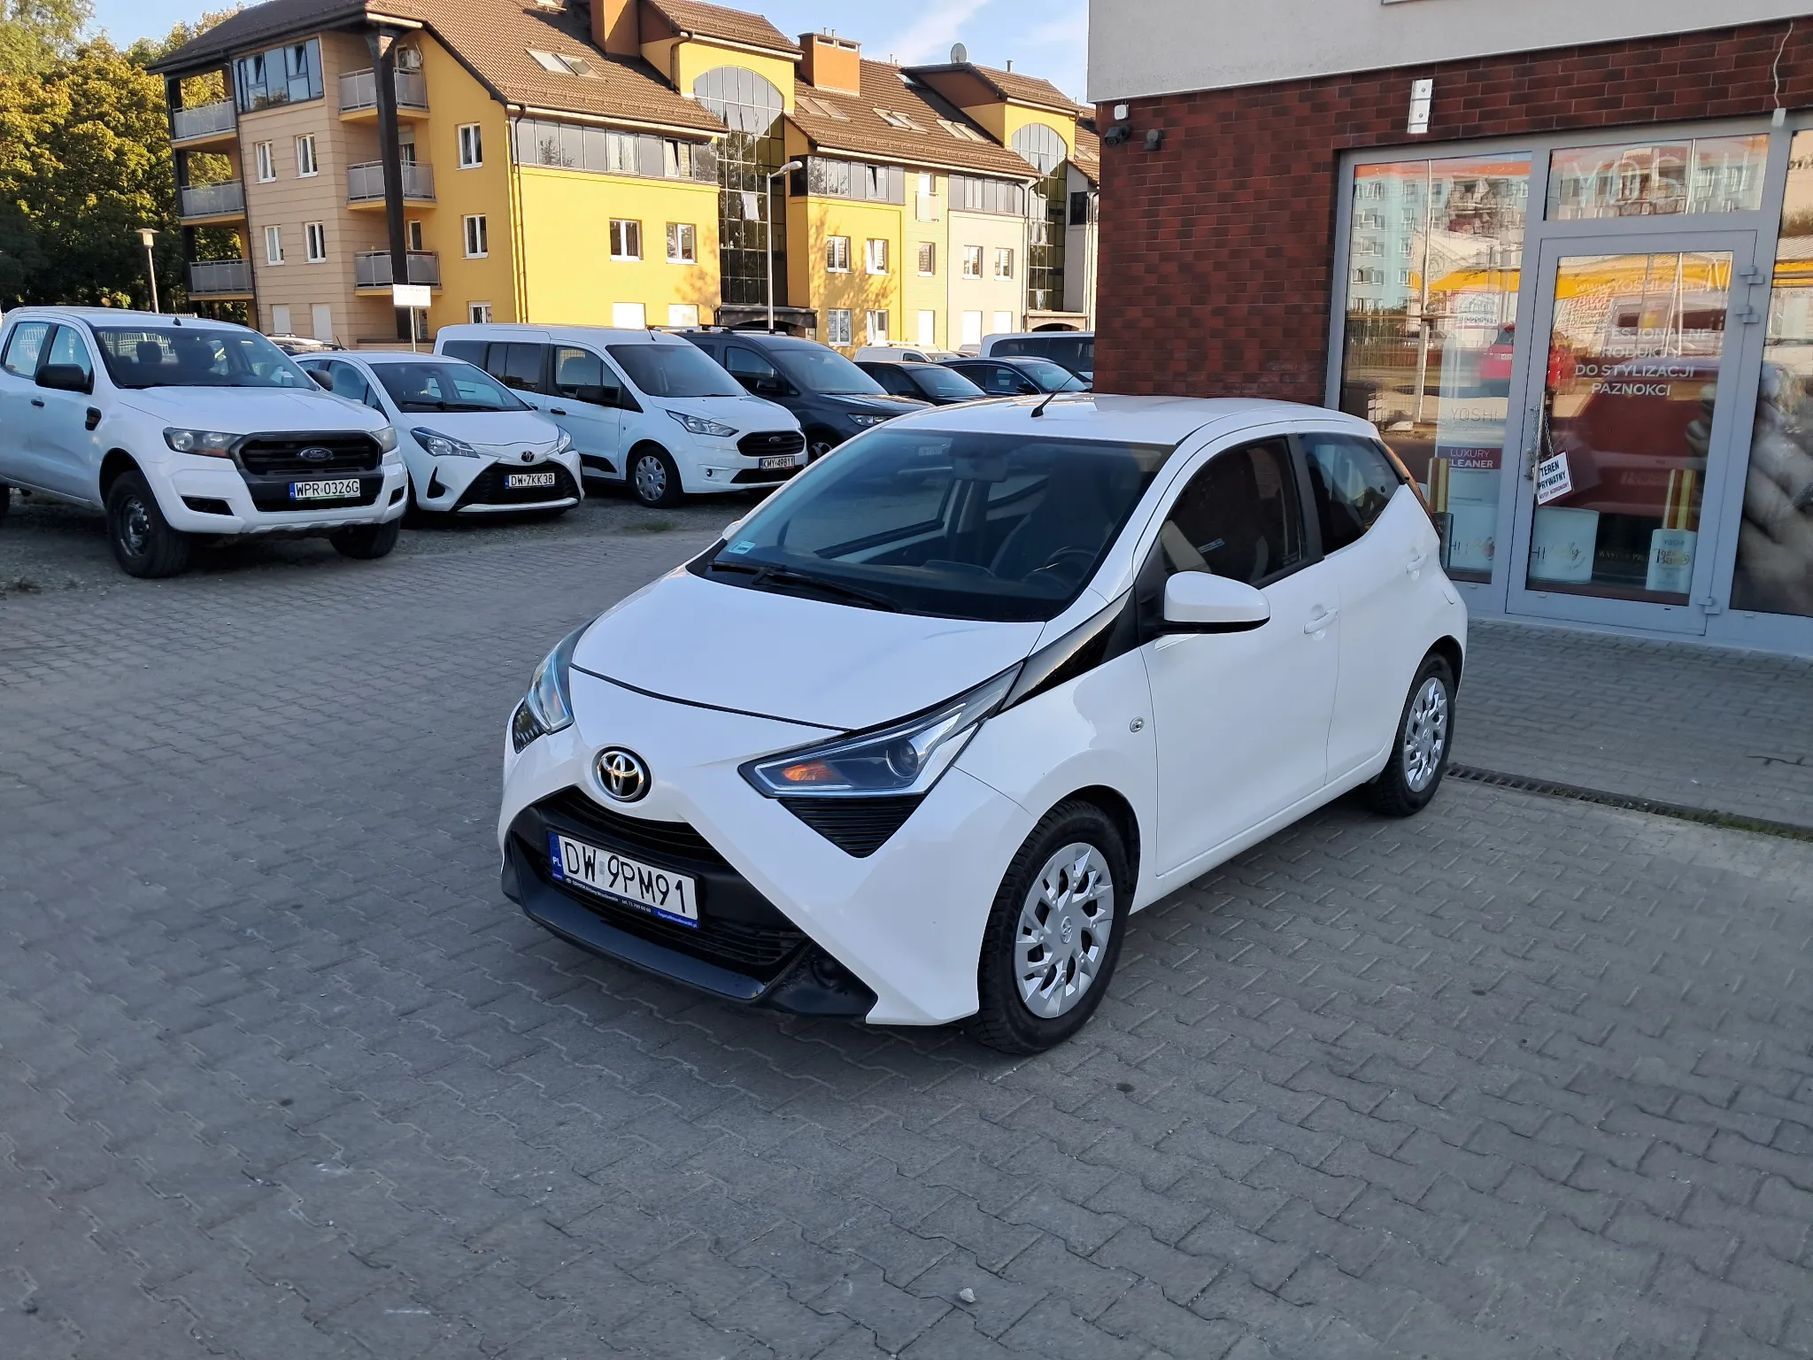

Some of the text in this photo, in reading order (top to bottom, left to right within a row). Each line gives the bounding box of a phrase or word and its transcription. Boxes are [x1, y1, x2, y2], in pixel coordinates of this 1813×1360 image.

[1575, 364, 1694, 378] DO STYLIZACJI
[1592, 383, 1671, 396] PAZNOKCI
[1450, 448, 1490, 459] LUXURY
[1448, 459, 1494, 468] LEANER
[1540, 460, 1560, 477] TEREN
[511, 475, 523, 486] DW
[296, 480, 359, 497] WPR 0326G
[564, 841, 686, 914] DW 9PM91
